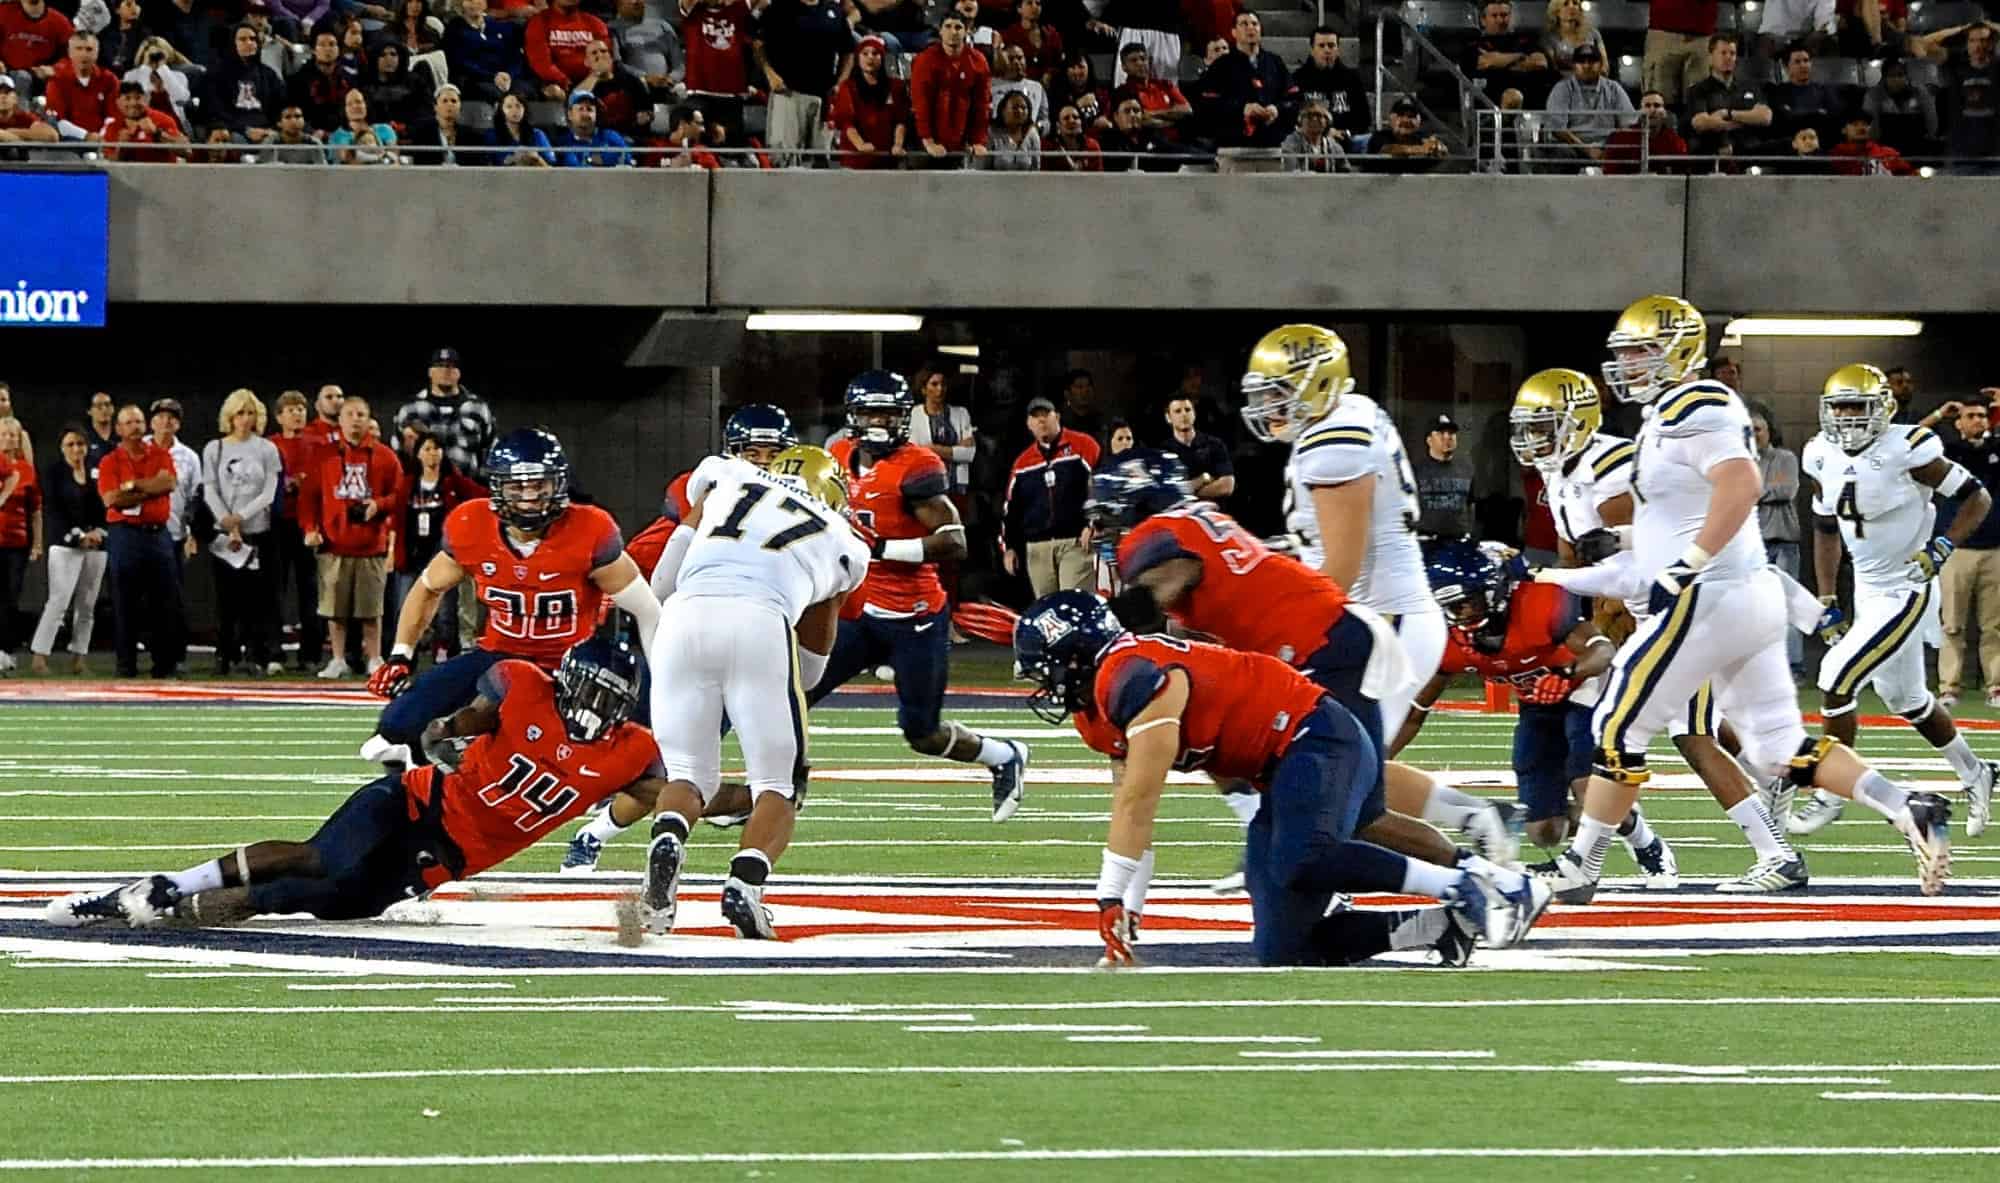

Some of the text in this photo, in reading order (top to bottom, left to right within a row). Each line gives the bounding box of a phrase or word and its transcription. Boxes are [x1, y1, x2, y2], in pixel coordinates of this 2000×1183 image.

[334, 462, 372, 500] A
[782, 459, 804, 475] 17
[706, 481, 829, 552] 17
[1560, 503, 1578, 543] 1
[1836, 481, 1865, 539] 4
[484, 586, 577, 640] 38
[1034, 608, 1073, 648] A
[477, 753, 580, 833] 14
